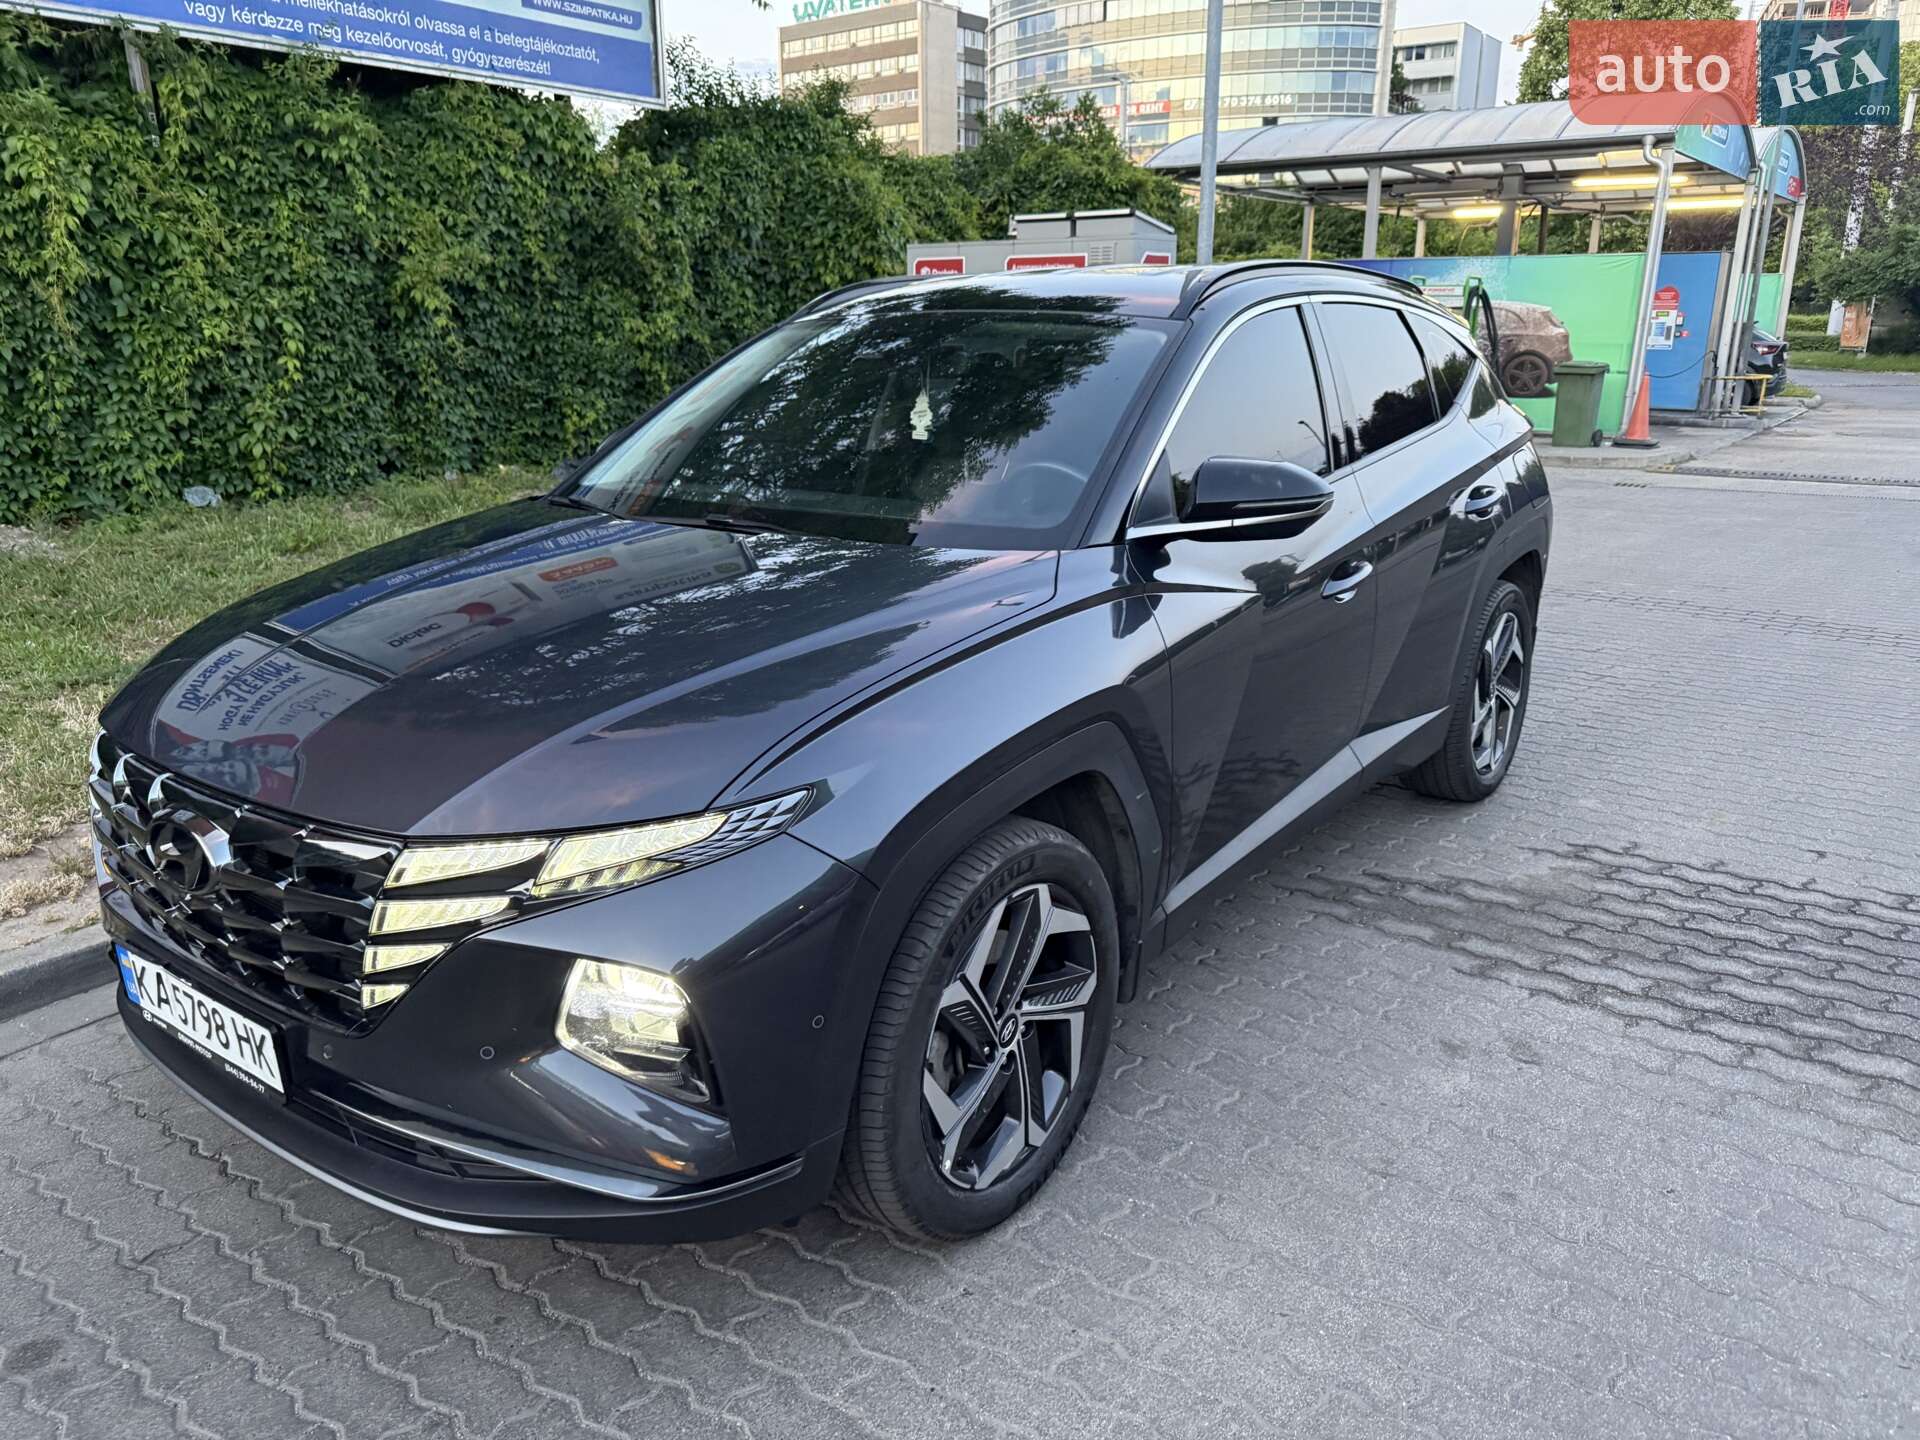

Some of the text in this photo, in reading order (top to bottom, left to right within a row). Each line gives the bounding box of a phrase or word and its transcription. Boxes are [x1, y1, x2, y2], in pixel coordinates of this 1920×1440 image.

[184, 0, 552, 76] vagy kérdezze meg kezelőorvosát, gyógyszerészét!
[415, 15, 466, 38] olvassa
[469, 27, 481, 40] el
[484, 32, 492, 42] a
[495, 28, 600, 64] betegtájékoztatót,
[1264, 93, 1293, 105] 6016
